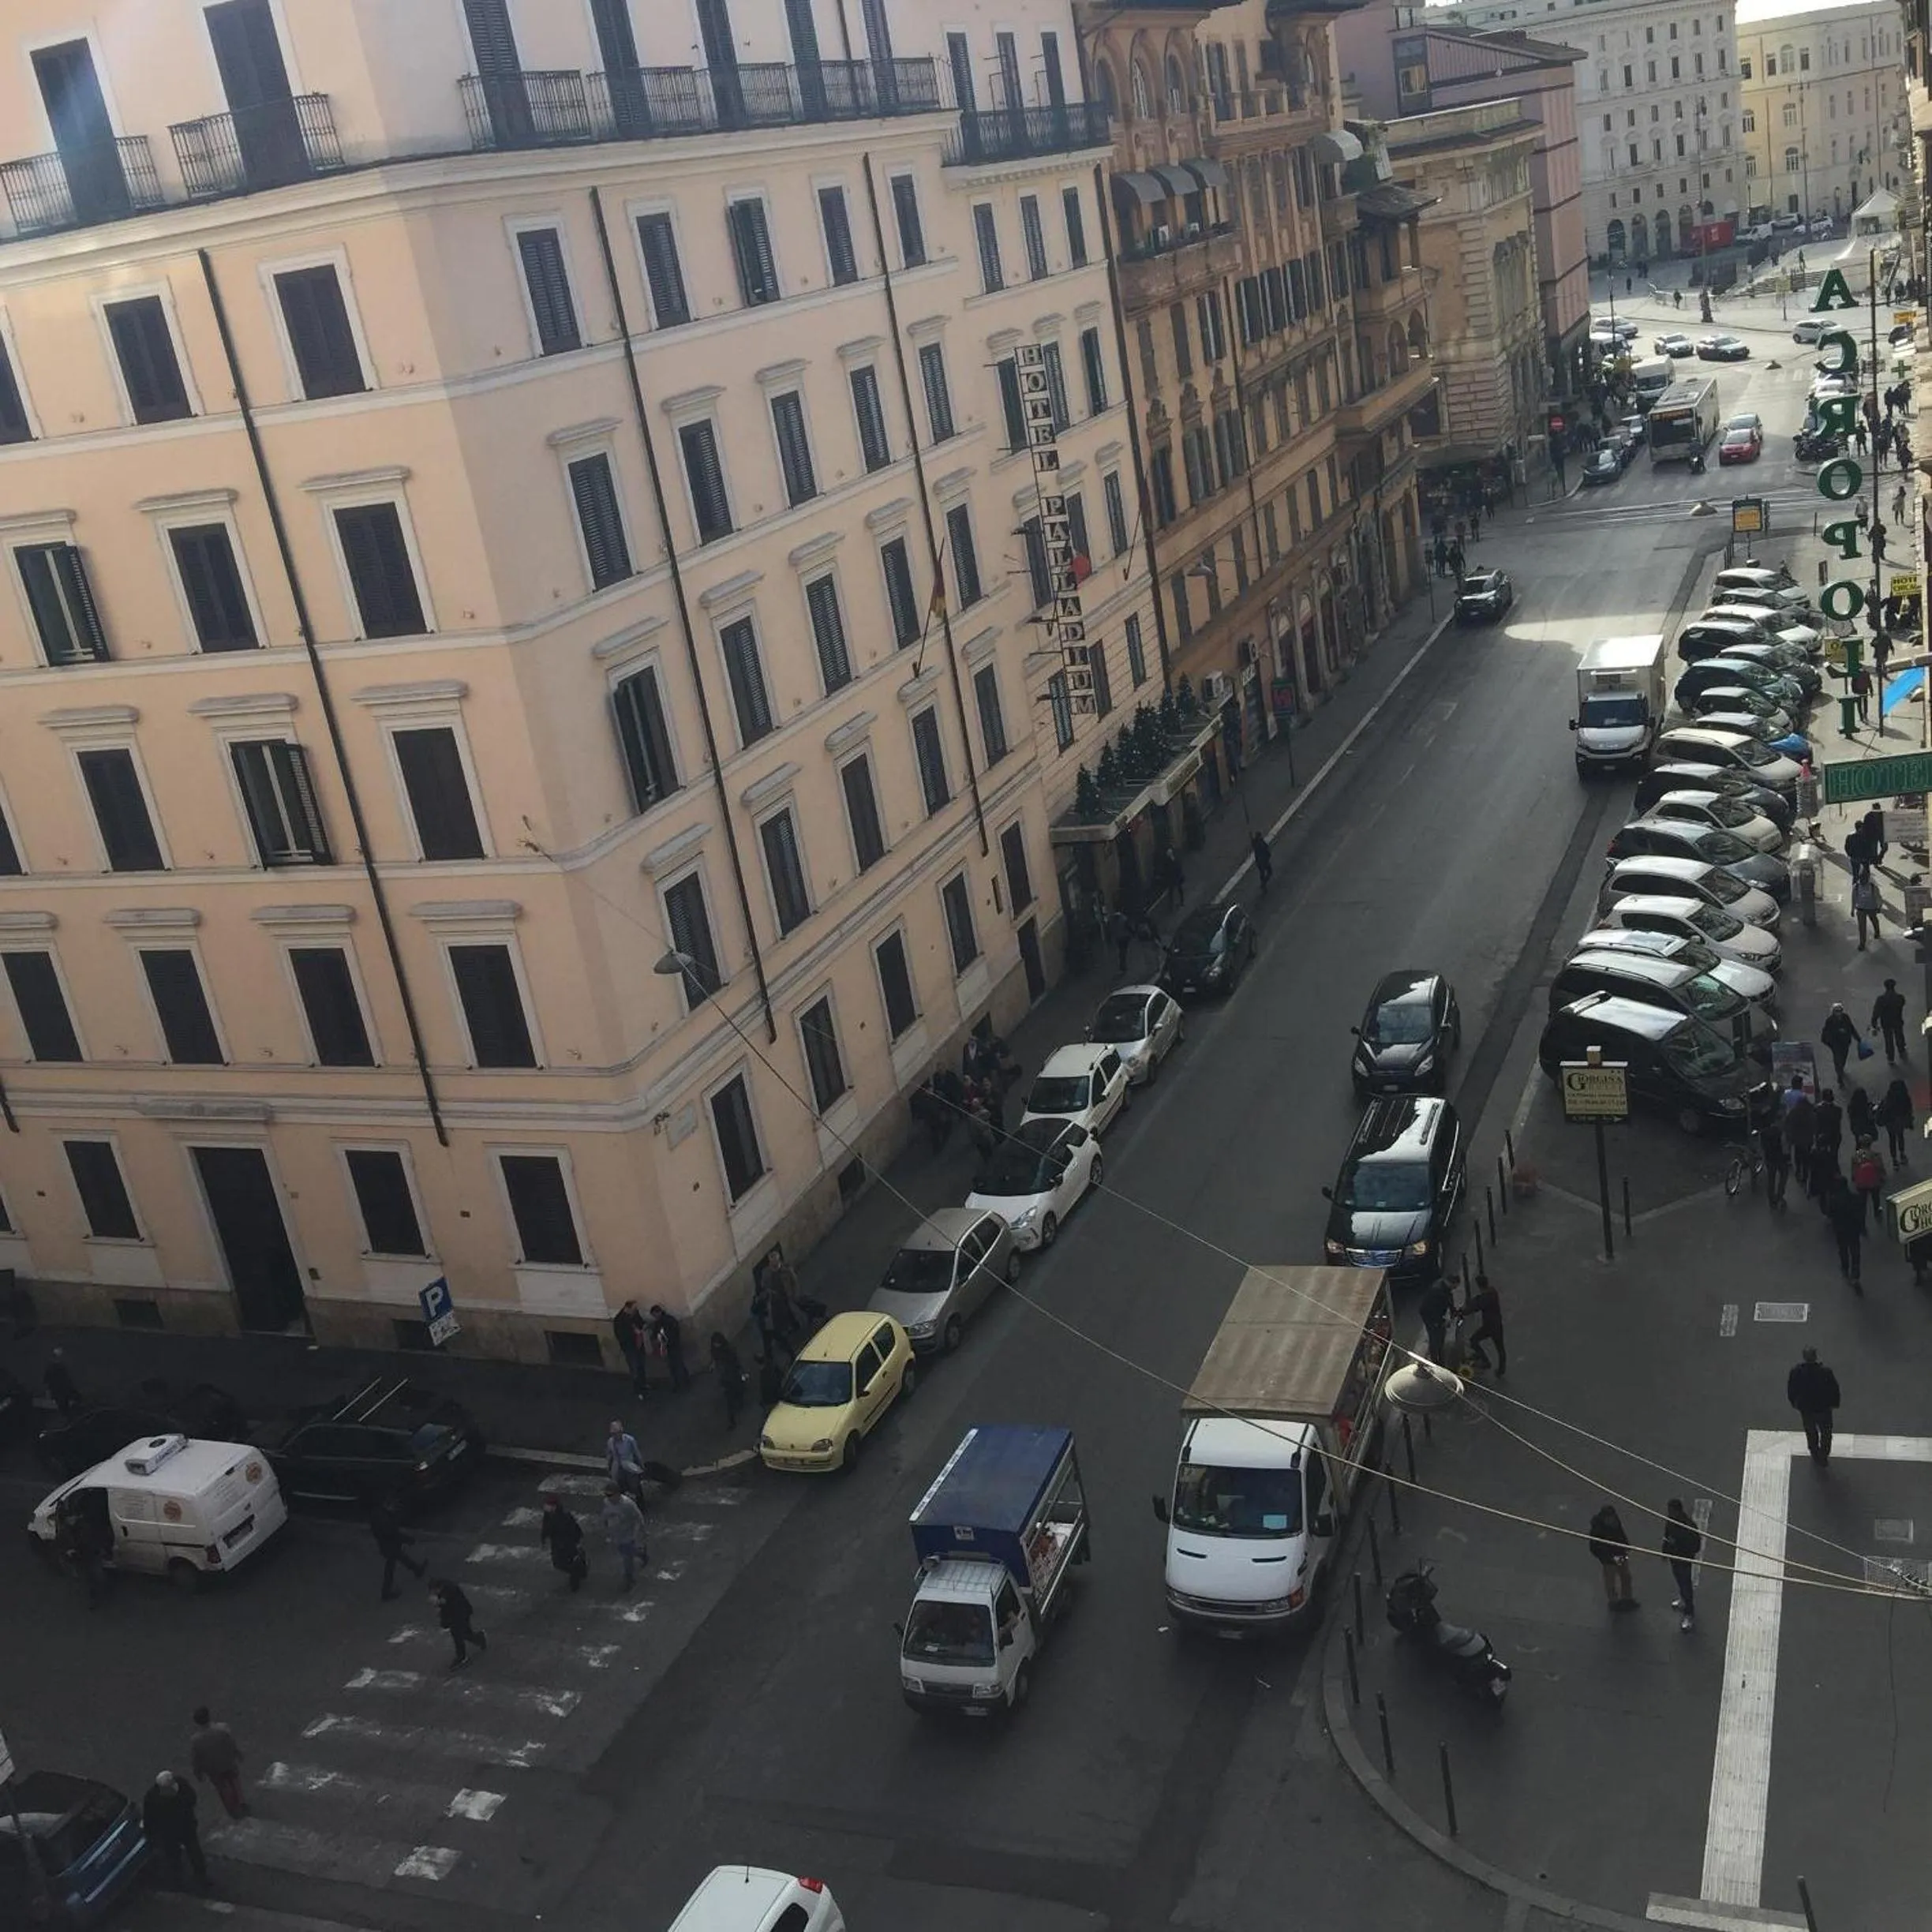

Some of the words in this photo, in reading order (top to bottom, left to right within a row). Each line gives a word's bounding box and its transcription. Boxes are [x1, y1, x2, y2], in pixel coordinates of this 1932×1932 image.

[1024, 346, 1058, 472] HOTEL
[1046, 497, 1095, 712] PALLADIUM
[426, 1286, 444, 1318] P
